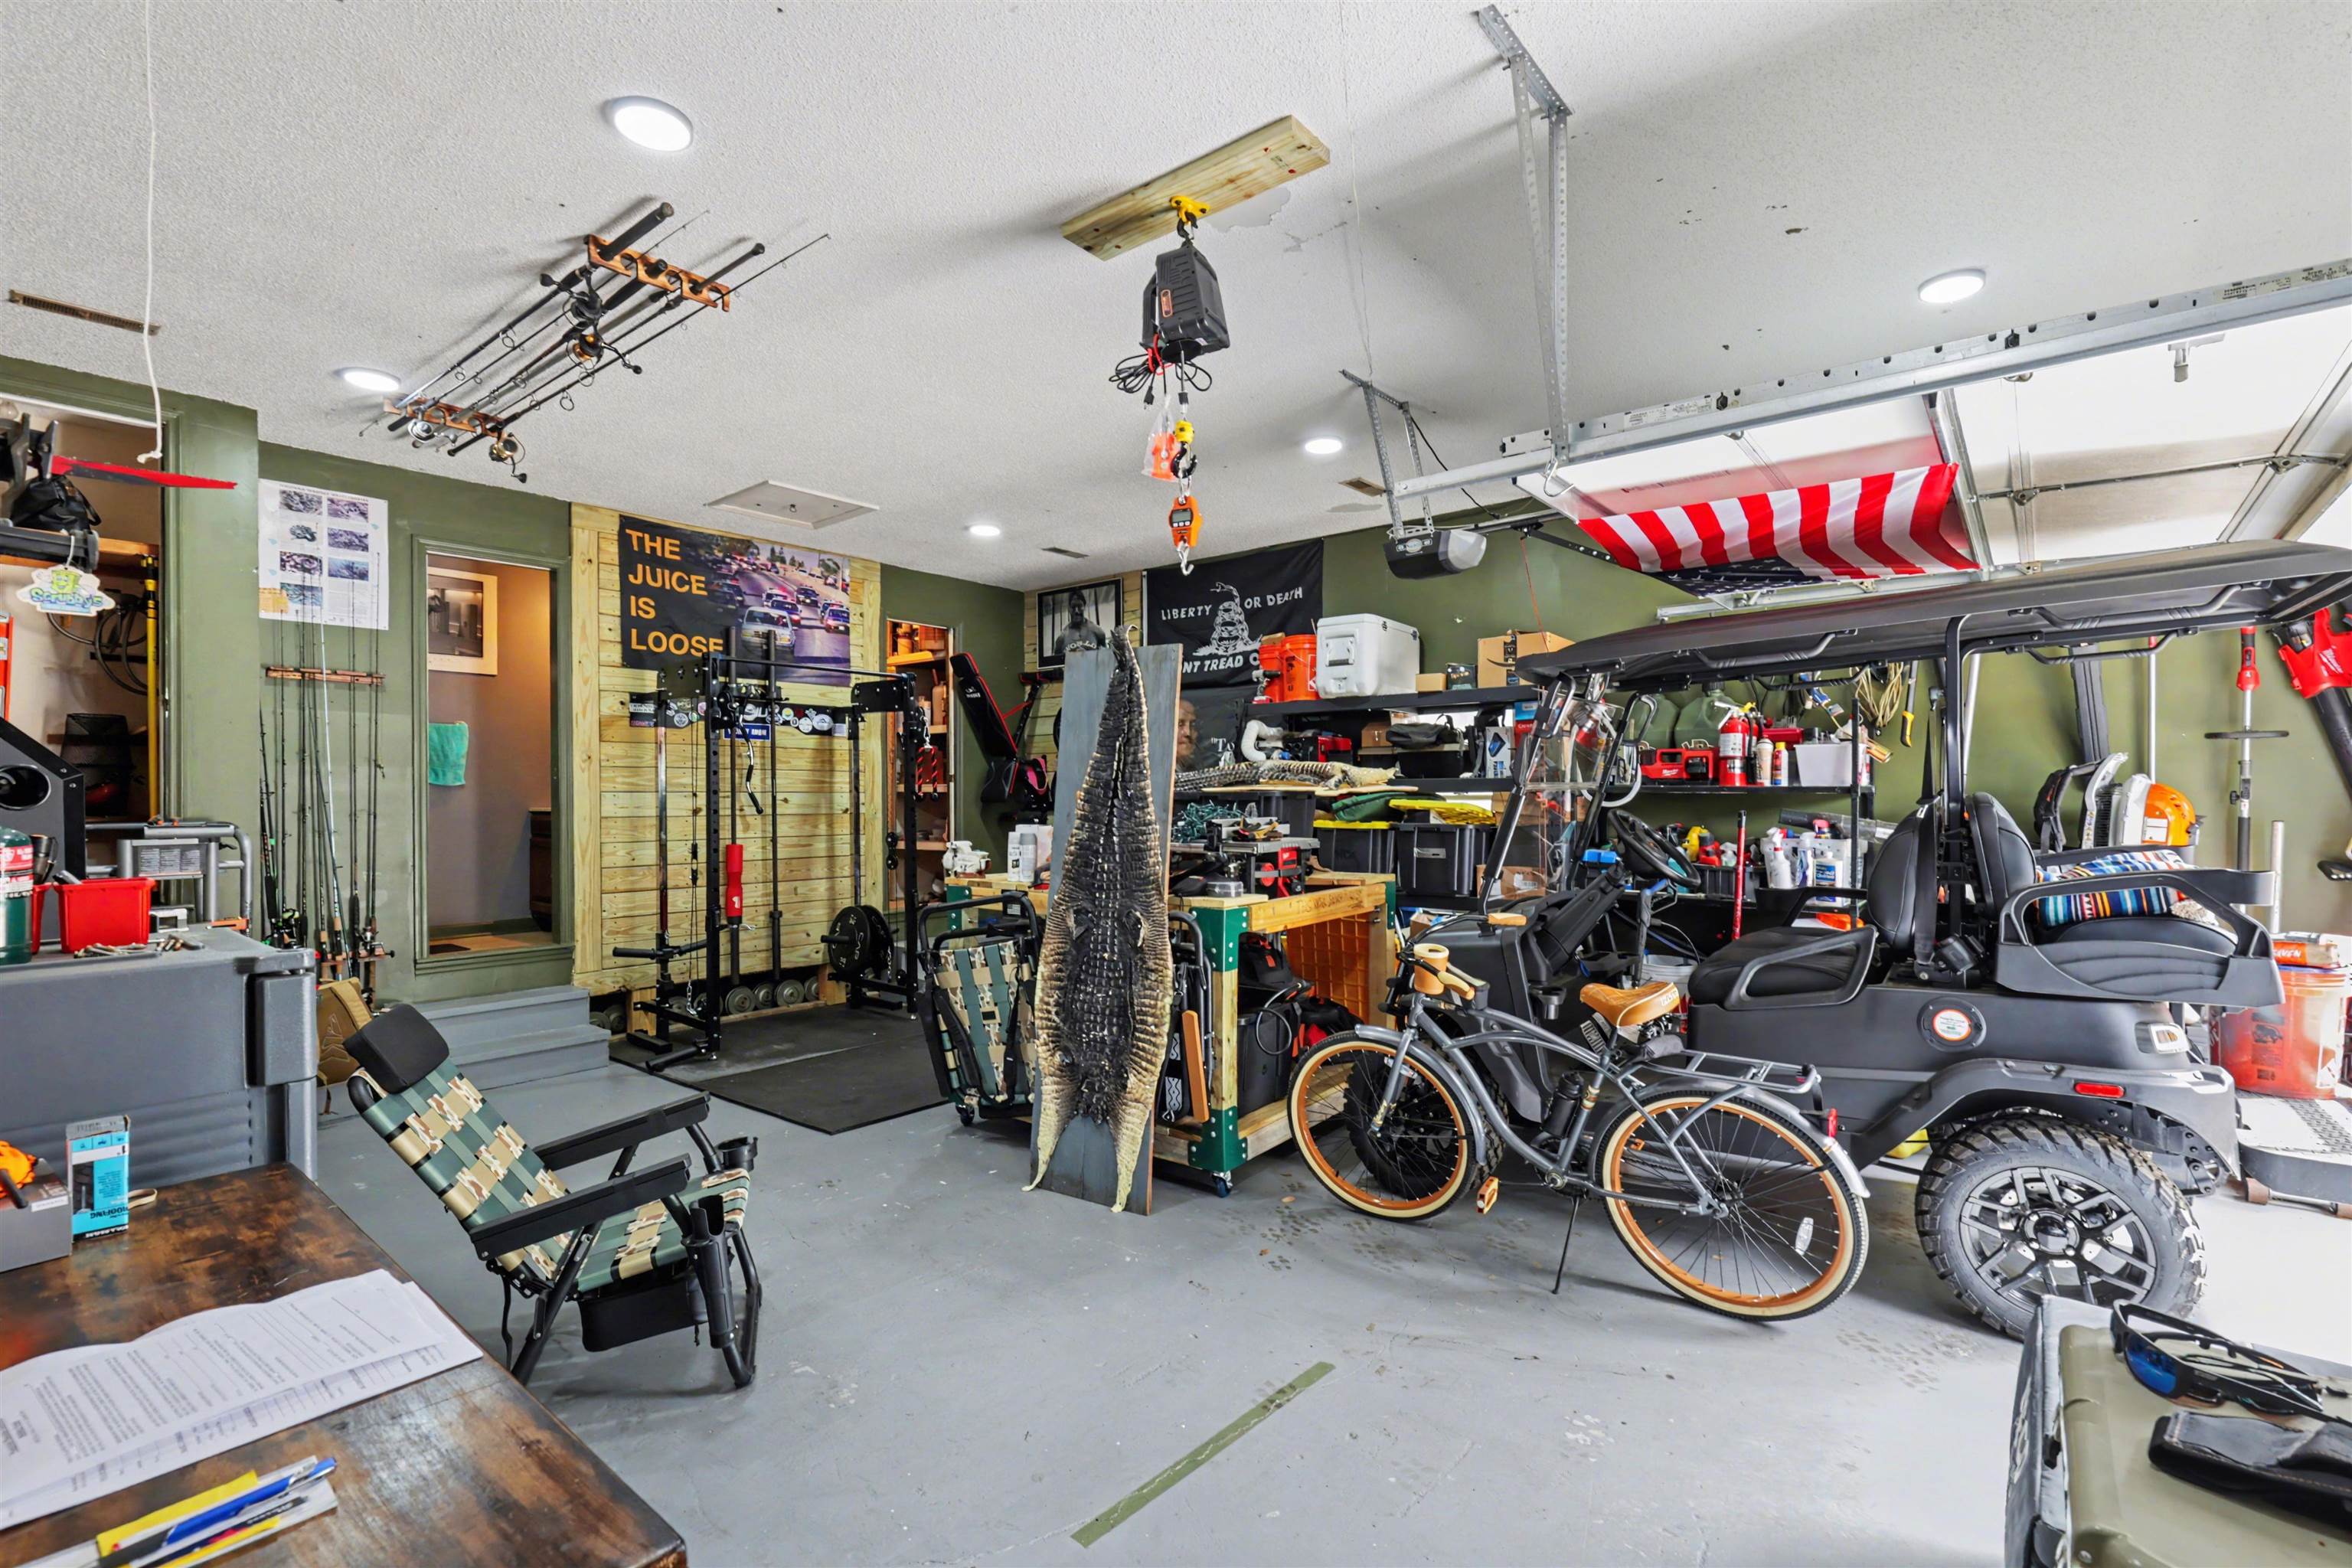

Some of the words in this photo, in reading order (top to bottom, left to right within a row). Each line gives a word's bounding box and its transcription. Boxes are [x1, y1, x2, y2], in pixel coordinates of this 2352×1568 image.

[625, 528, 681, 560] THE
[628, 563, 708, 596] JUICE
[629, 595, 656, 619] IS
[1161, 604, 1213, 621] LIBERTY
[1244, 596, 1263, 609] OR
[1266, 586, 1304, 608] DEATH
[1182, 660, 1201, 674] NT
[1203, 654, 1244, 672] TREAD
[1249, 652, 1259, 666] O
